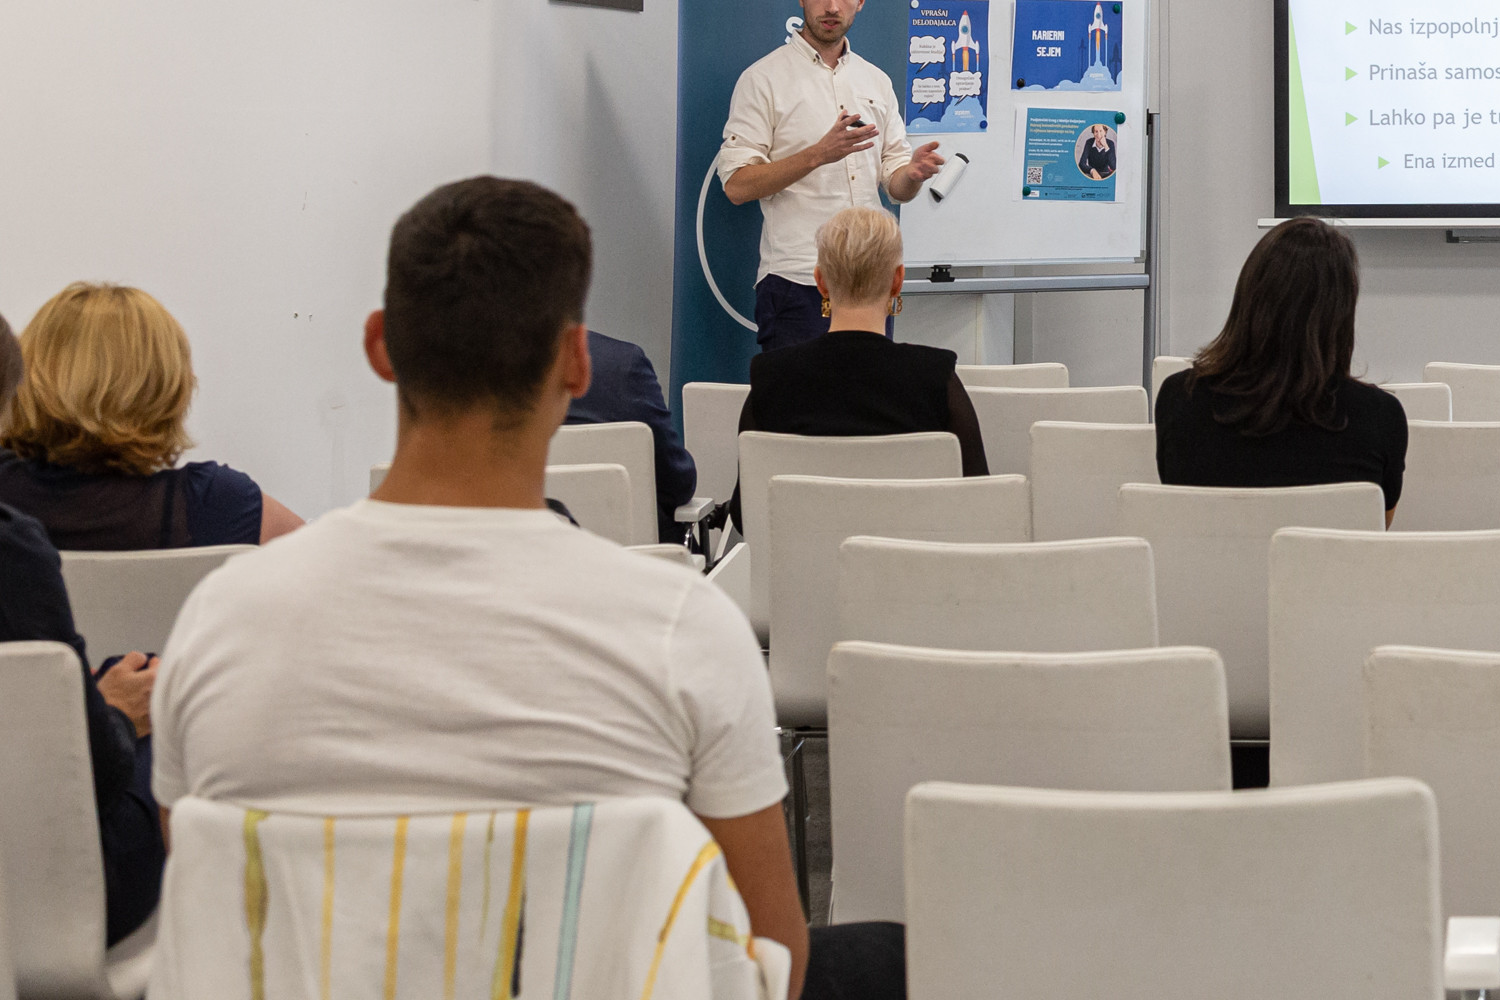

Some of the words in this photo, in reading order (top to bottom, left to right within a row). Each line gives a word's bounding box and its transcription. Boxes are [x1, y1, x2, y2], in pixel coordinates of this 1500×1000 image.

[920, 8, 949, 18] VPRAŠAJ
[912, 18, 957, 27] DELODAJALCA
[1369, 17, 1403, 36] Nas
[1032, 30, 1065, 41] KARIERNI
[1036, 46, 1062, 57] SEJEM
[1369, 61, 1438, 81] Prinaša
[1369, 107, 1426, 126] Lahko
[1432, 112, 1456, 130] pa
[1462, 108, 1483, 130] je
[1404, 153, 1436, 169] Ena
[1441, 152, 1495, 169] izmed
